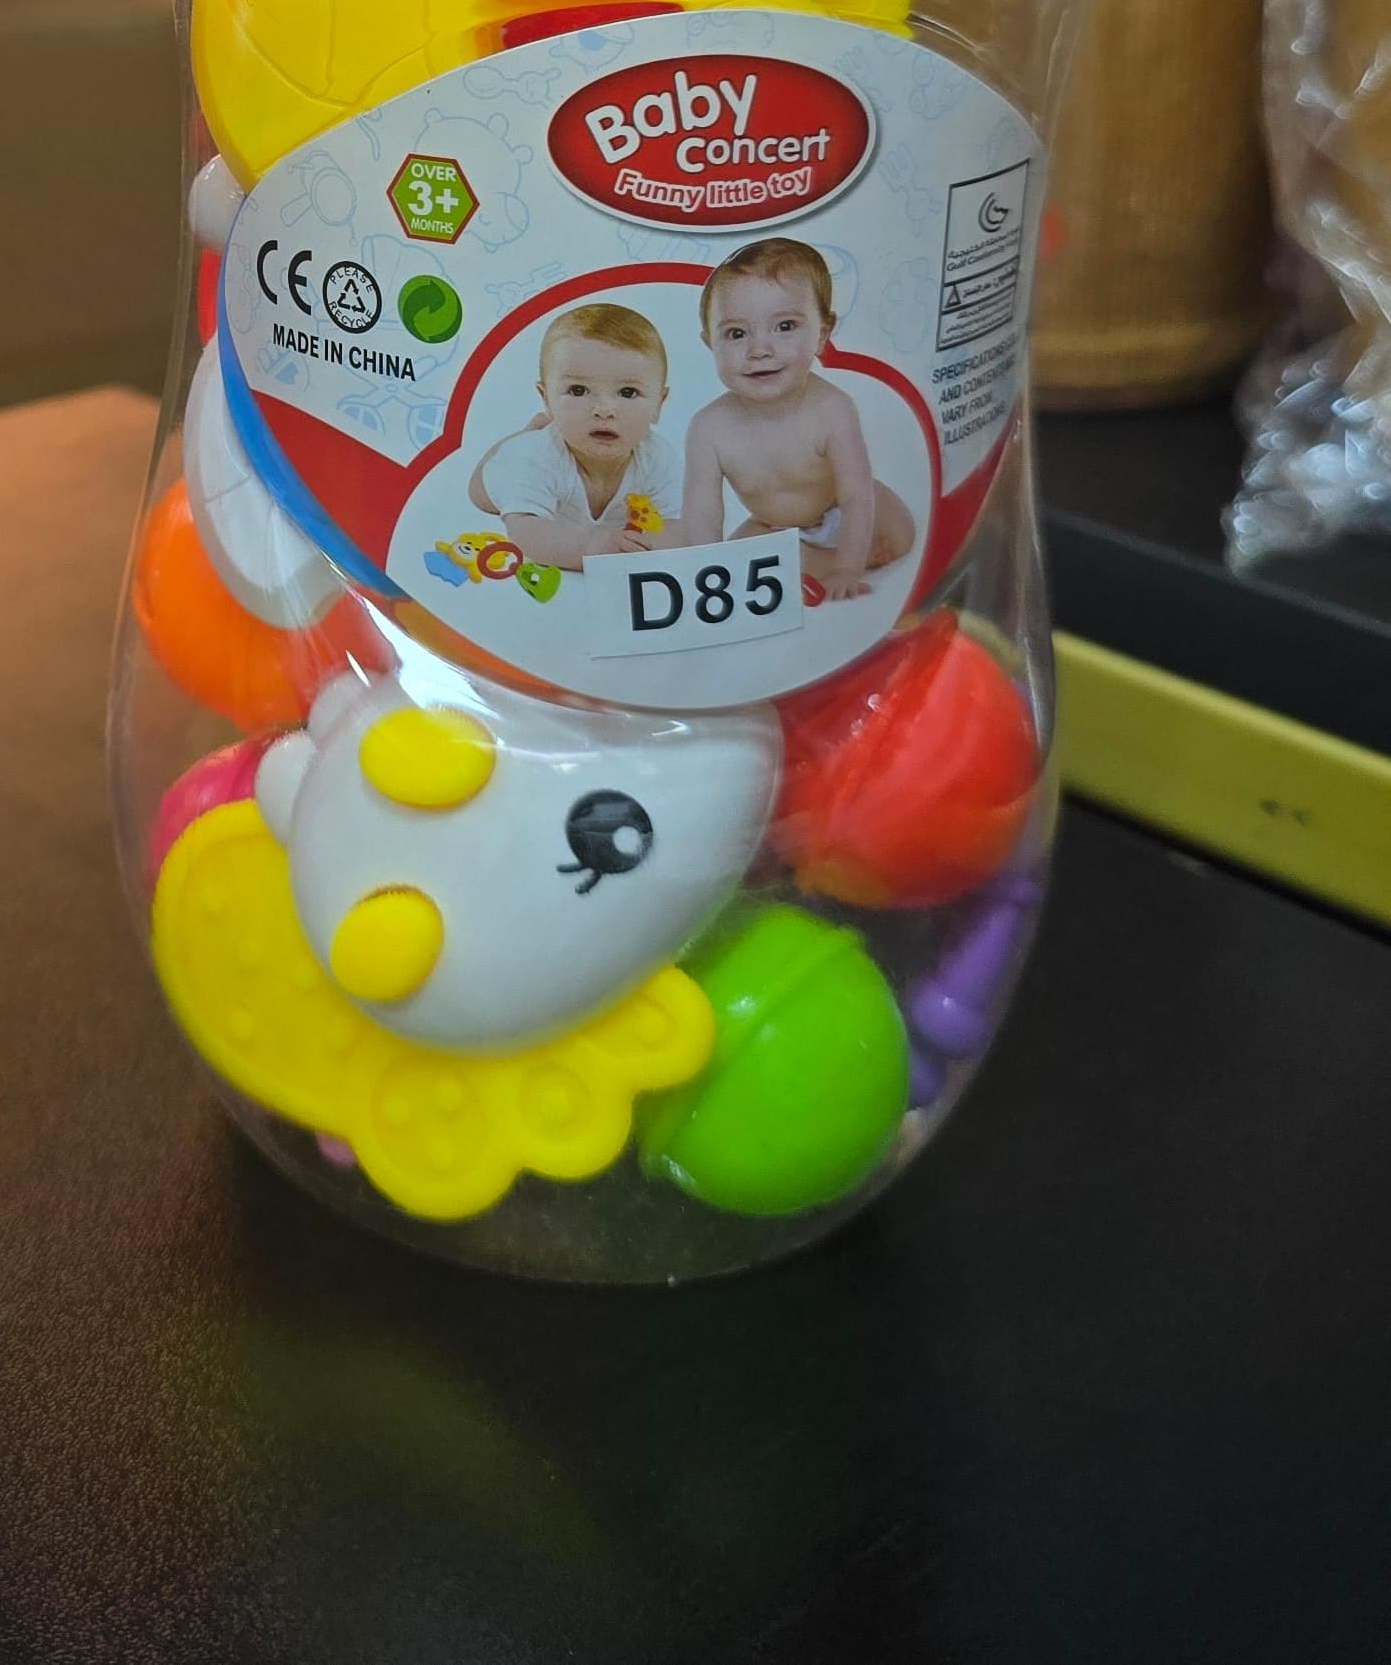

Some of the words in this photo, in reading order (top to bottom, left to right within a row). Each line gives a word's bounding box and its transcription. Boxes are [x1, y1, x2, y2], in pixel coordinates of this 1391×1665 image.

[585, 71, 757, 164] Baby
[410, 163, 457, 183] OVER
[615, 168, 704, 213] Funny
[706, 180, 768, 208] little
[768, 166, 811, 198] toy
[408, 181, 459, 216] 3+
[411, 217, 454, 235] MONTHS
[330, 266, 373, 293] PLEASE
[329, 301, 372, 328] RECYCLE
[273, 323, 320, 359] MADE
[324, 342, 343, 369] IN
[348, 346, 416, 382] CHINA
[628, 555, 784, 631] D85
